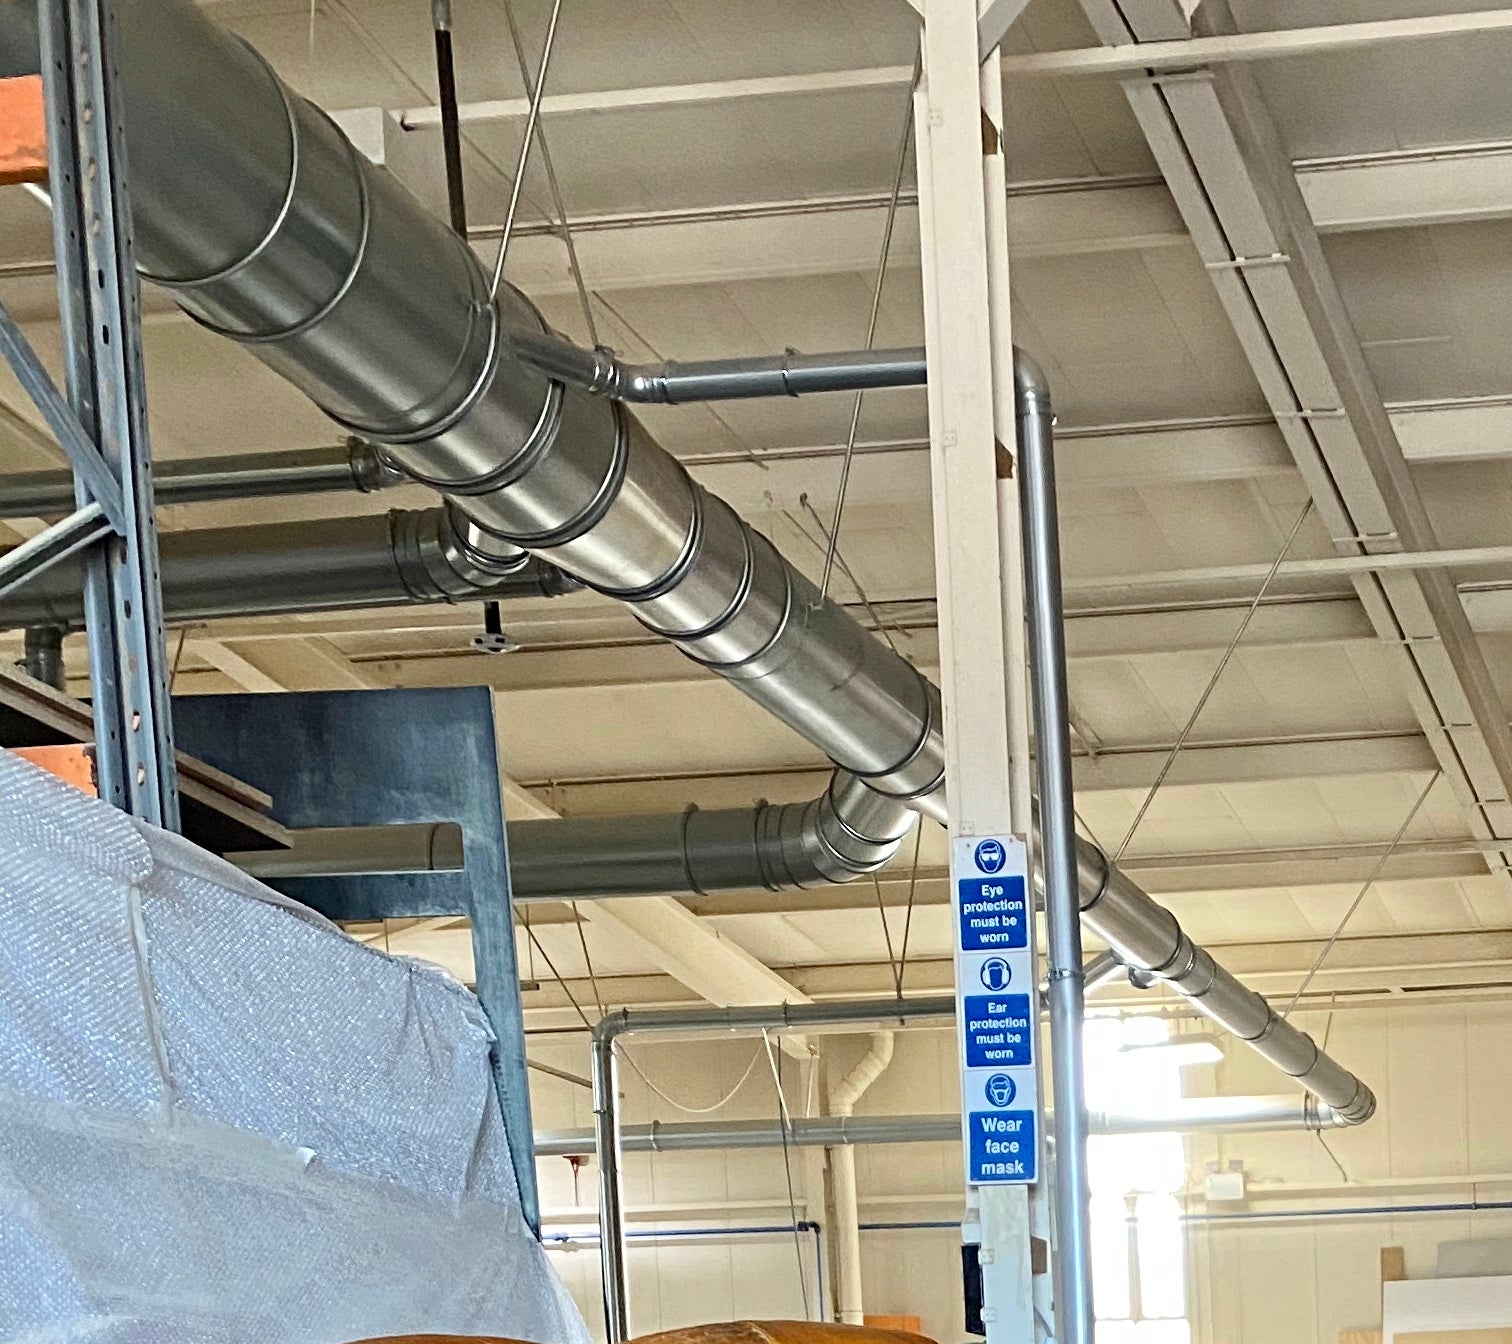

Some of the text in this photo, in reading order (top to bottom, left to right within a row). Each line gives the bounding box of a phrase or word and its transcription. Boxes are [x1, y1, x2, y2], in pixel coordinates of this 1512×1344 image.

[981, 884, 1004, 899] Eye
[963, 899, 1023, 915] protection
[970, 914, 1018, 928] must be
[979, 932, 1009, 943] worn
[987, 1001, 1008, 1014] Ear
[969, 1016, 1027, 1033] protection
[975, 1031, 1022, 1045] must be
[984, 1049, 1014, 1060] worn
[980, 1117, 1023, 1133] Wear
[984, 1138, 1020, 1155] face
[981, 1159, 1025, 1176] mask
